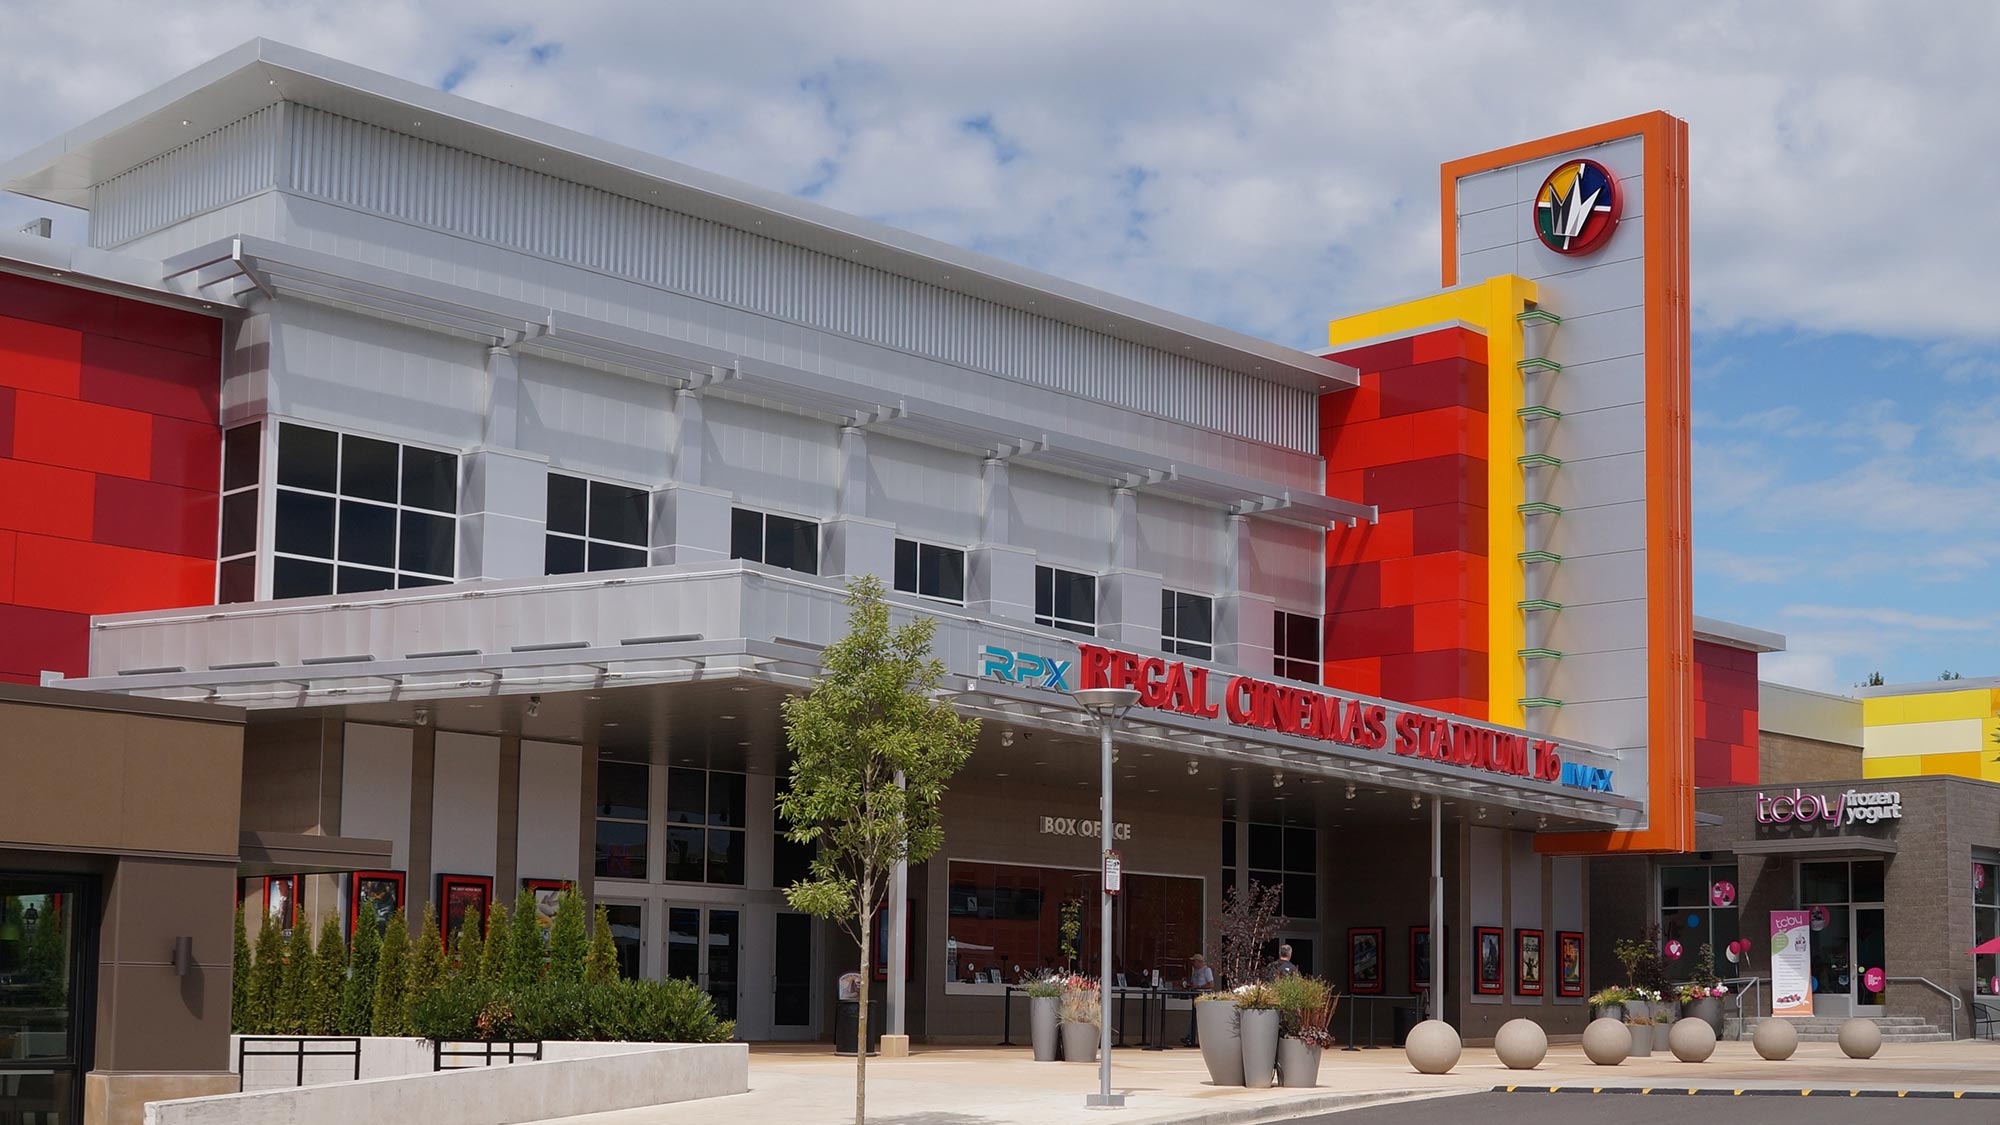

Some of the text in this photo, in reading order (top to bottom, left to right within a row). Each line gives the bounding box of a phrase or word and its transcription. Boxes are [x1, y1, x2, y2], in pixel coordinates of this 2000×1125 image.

[978, 643, 1072, 691] RPX
[1077, 643, 1561, 782] REGAL CINEMAS STADIUM 16
[1561, 761, 1614, 793] IMAX
[1756, 788, 1846, 828] tcby
[1845, 789, 1900, 806] frozen
[1040, 815, 1131, 840] BOX OFCE
[1846, 803, 1902, 825] yogurt
